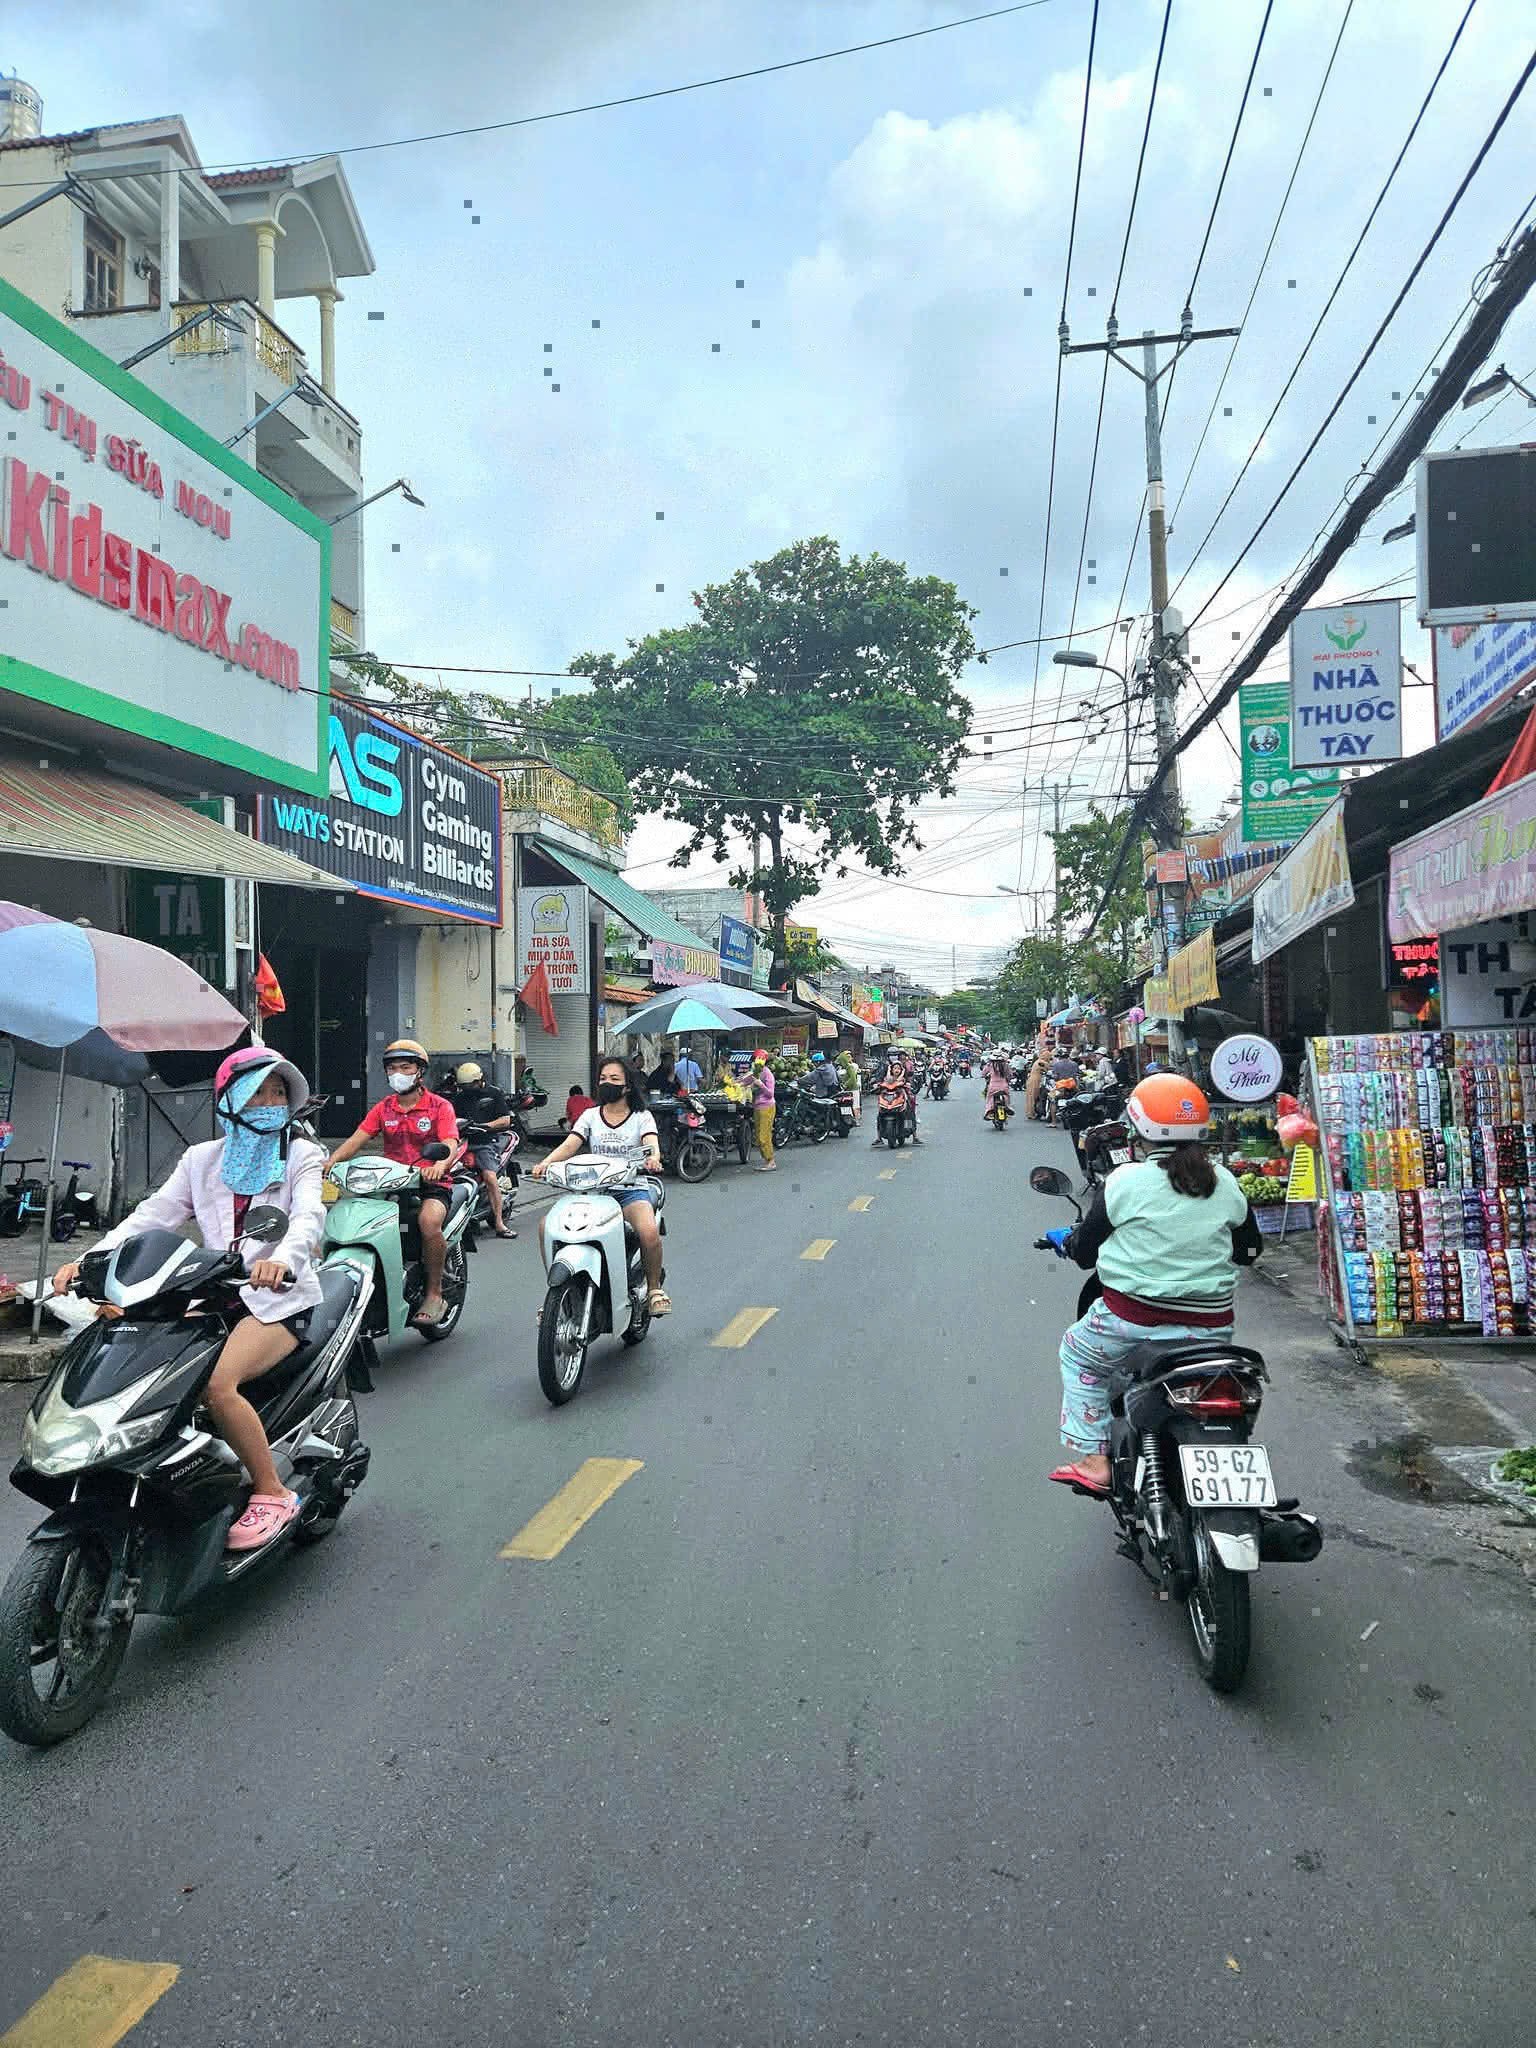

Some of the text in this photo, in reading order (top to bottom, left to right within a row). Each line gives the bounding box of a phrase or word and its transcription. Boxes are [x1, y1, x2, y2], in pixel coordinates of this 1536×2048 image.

[40, 388, 97, 463] THỊ
[104, 434, 164, 499] SỮA
[174, 480, 231, 541] NON
[4, 456, 299, 692] Kidsmax.com
[1312, 664, 1380, 693] NHÀ
[1298, 695, 1397, 728] THUỐC
[1319, 732, 1376, 758] TÂY
[421, 757, 466, 805] Gym
[273, 797, 404, 865] WAYS STATION
[421, 800, 493, 861] Gaming
[421, 842, 494, 892] Billiards
[531, 937, 549, 948] TRÀ
[527, 951, 551, 961] MILO
[523, 964, 537, 975] KE
[1227, 1045, 1261, 1067] Mỹ
[1226, 1069, 1272, 1090] Phẩm
[170, 1456, 204, 1481] HONDA
[1193, 1449, 1257, 1474] 59-G2
[1191, 1477, 1267, 1502] 691.77
